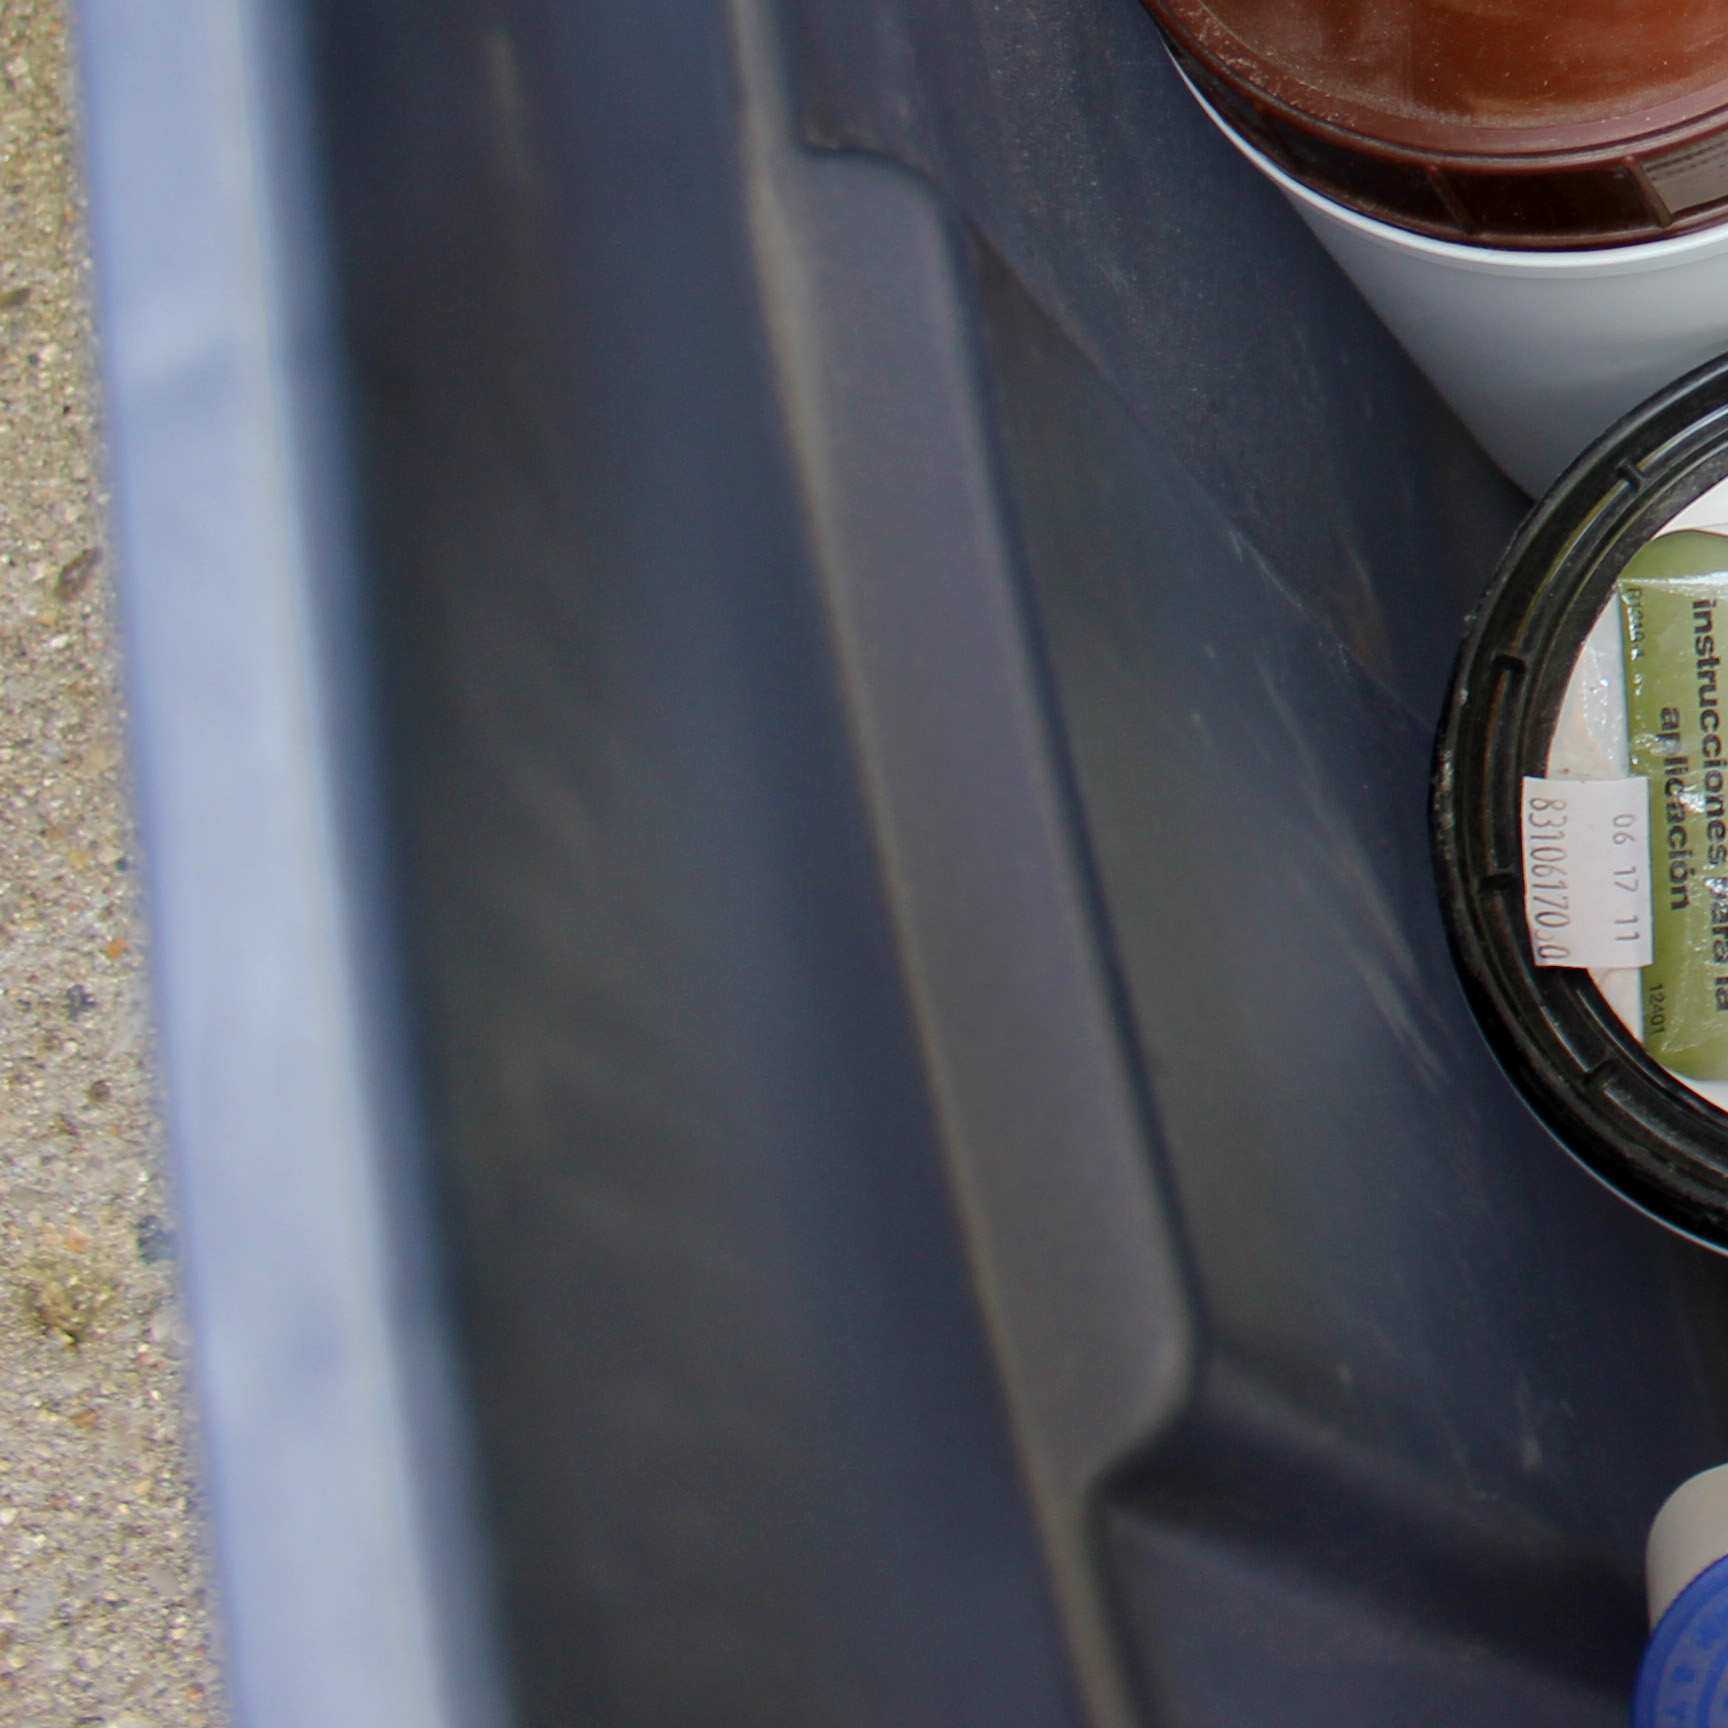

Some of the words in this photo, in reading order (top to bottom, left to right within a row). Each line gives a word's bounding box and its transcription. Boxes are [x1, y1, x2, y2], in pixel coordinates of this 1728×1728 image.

[1692, 599, 1728, 866] instrucciones
[1655, 707, 1694, 910] aplicación
[1612, 814, 1636, 845] 06
[1613, 866, 1639, 892] 17
[1613, 915, 1641, 941] 11
[1648, 983, 1665, 1035] 12401
